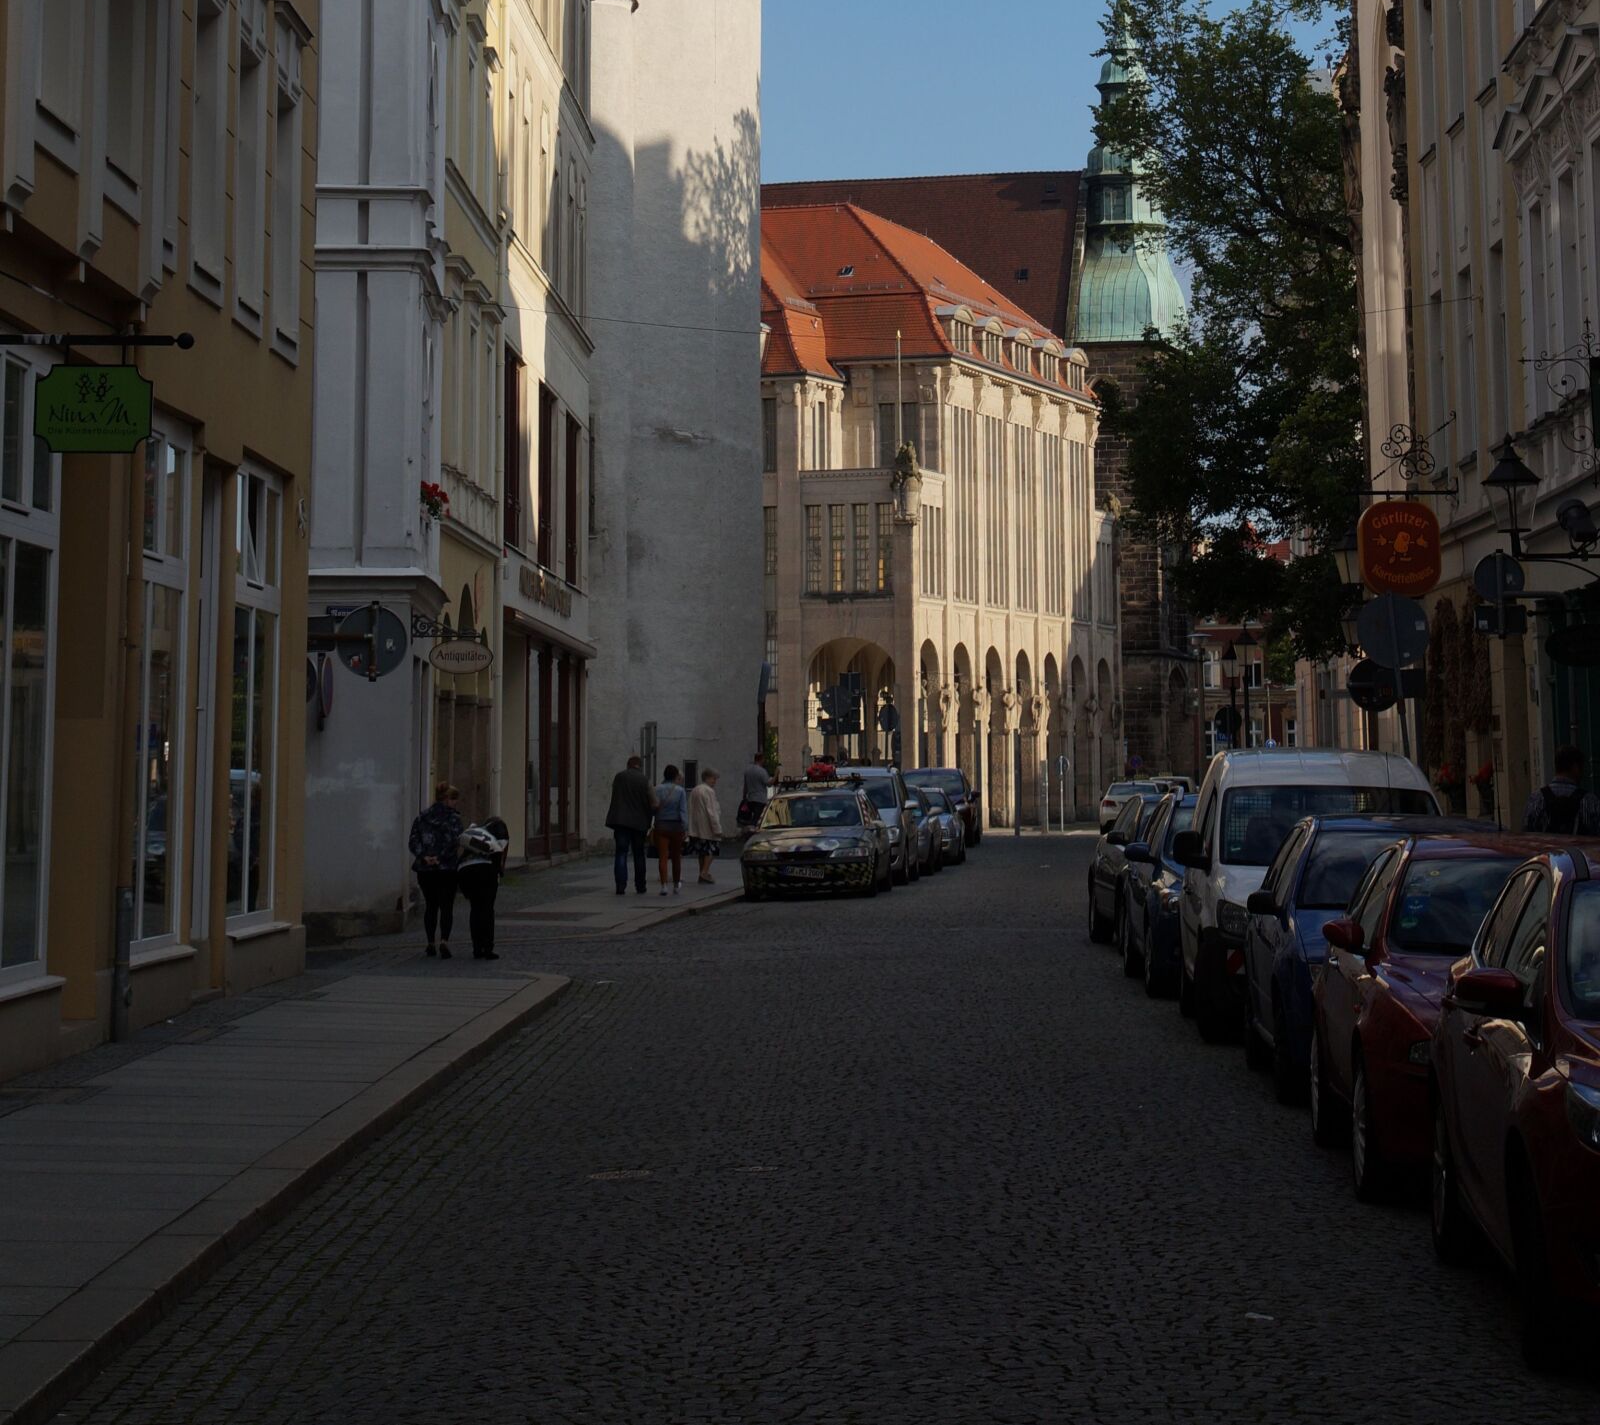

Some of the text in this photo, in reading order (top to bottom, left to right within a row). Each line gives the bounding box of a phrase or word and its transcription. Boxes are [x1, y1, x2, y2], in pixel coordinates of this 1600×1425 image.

[48, 403, 97, 423] Nina
[1372, 512, 1430, 529] Görlitzer
[435, 650, 487, 664] Antiquitäten
